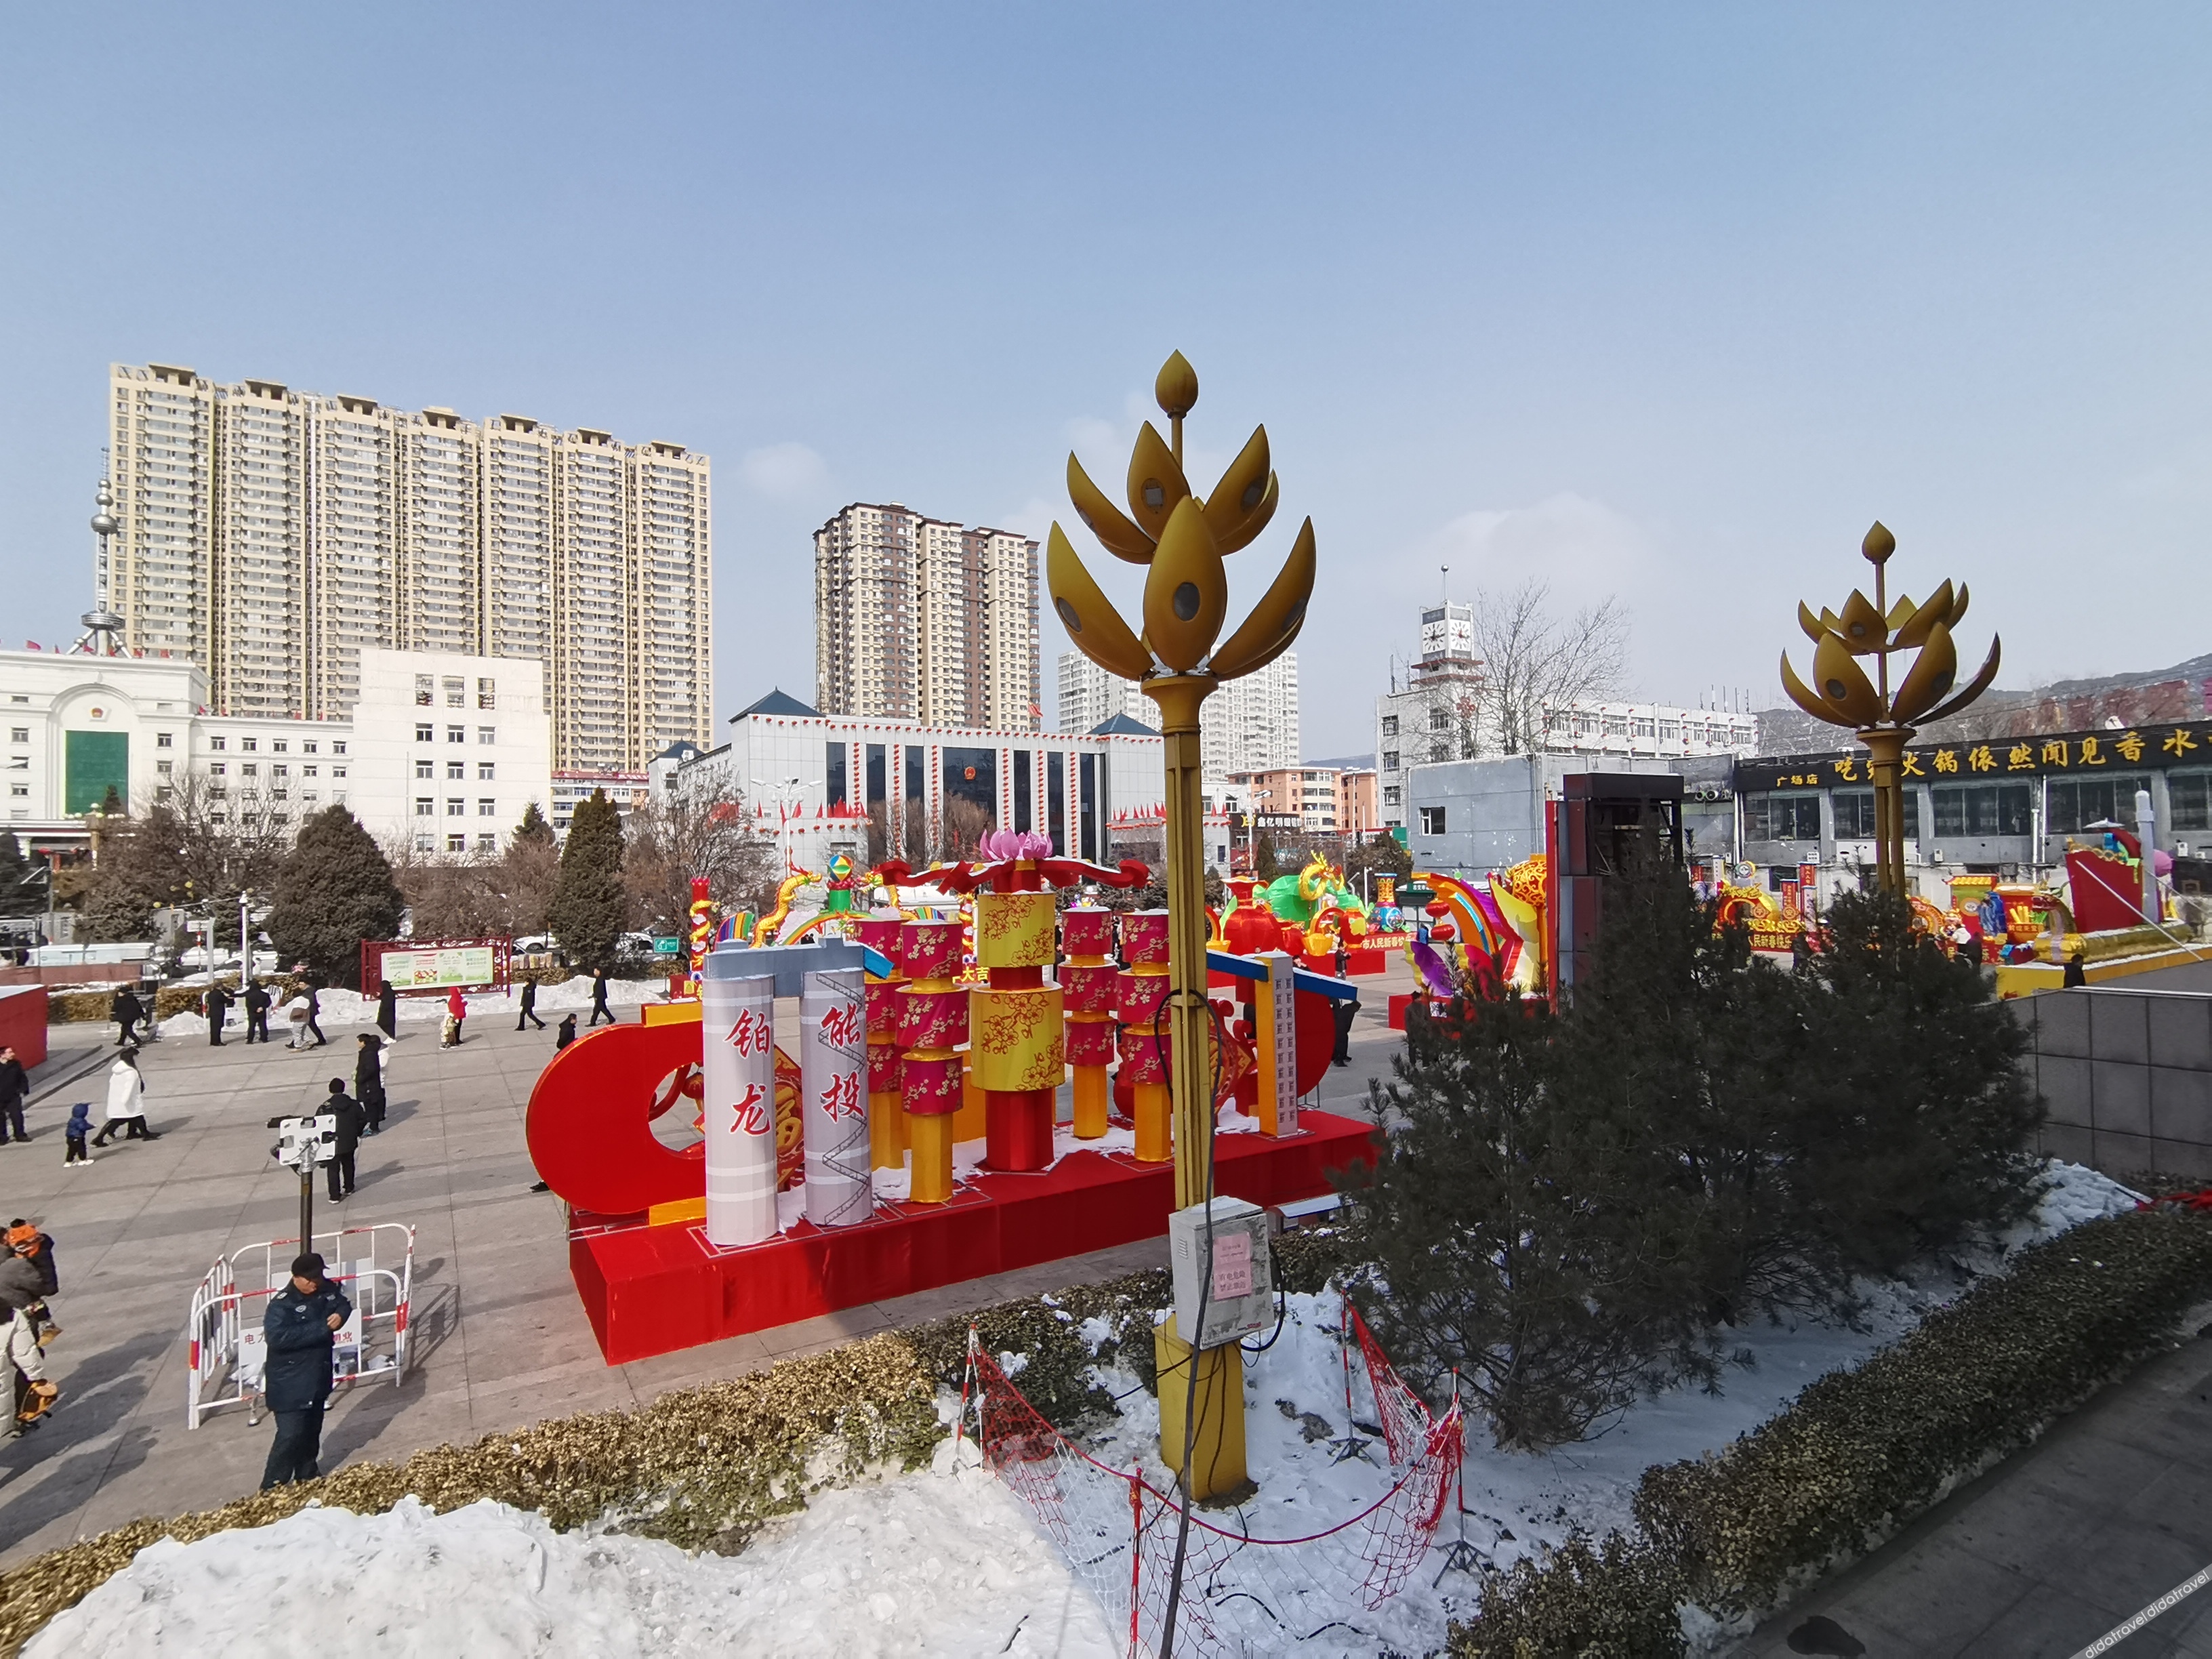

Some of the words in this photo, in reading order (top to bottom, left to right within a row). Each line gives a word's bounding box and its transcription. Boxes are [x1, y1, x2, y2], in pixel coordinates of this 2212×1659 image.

[1776, 774, 1818, 787] 广场店
[1835, 728, 2212, 781] 吃火锅依然闻见香水
[723, 1008, 771, 1137] 铂龙
[820, 1001, 865, 1124] 能投
